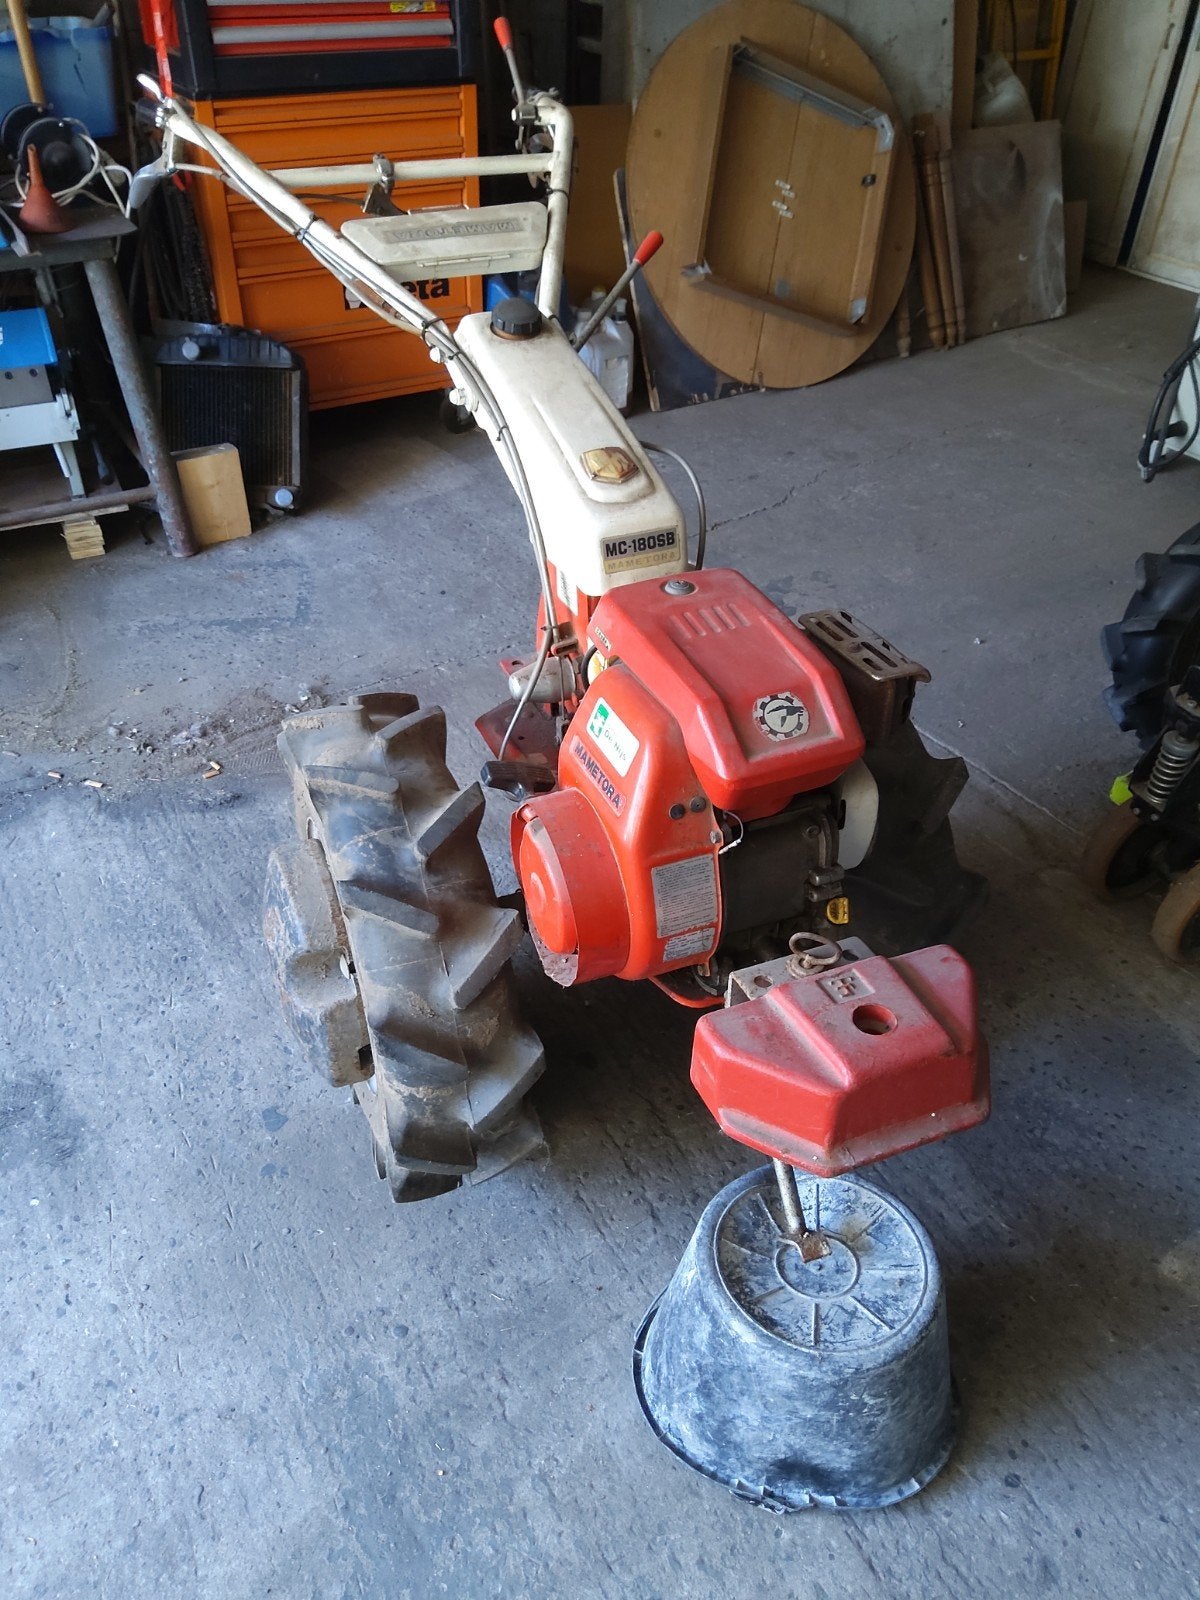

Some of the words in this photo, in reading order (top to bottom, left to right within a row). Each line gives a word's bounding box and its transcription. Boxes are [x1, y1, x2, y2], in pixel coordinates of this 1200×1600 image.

[401, 277, 450, 300] eta
[605, 531, 675, 557] MC-180SB
[608, 551, 676, 570] MAMETORA
[574, 741, 621, 809] MAMETORA
